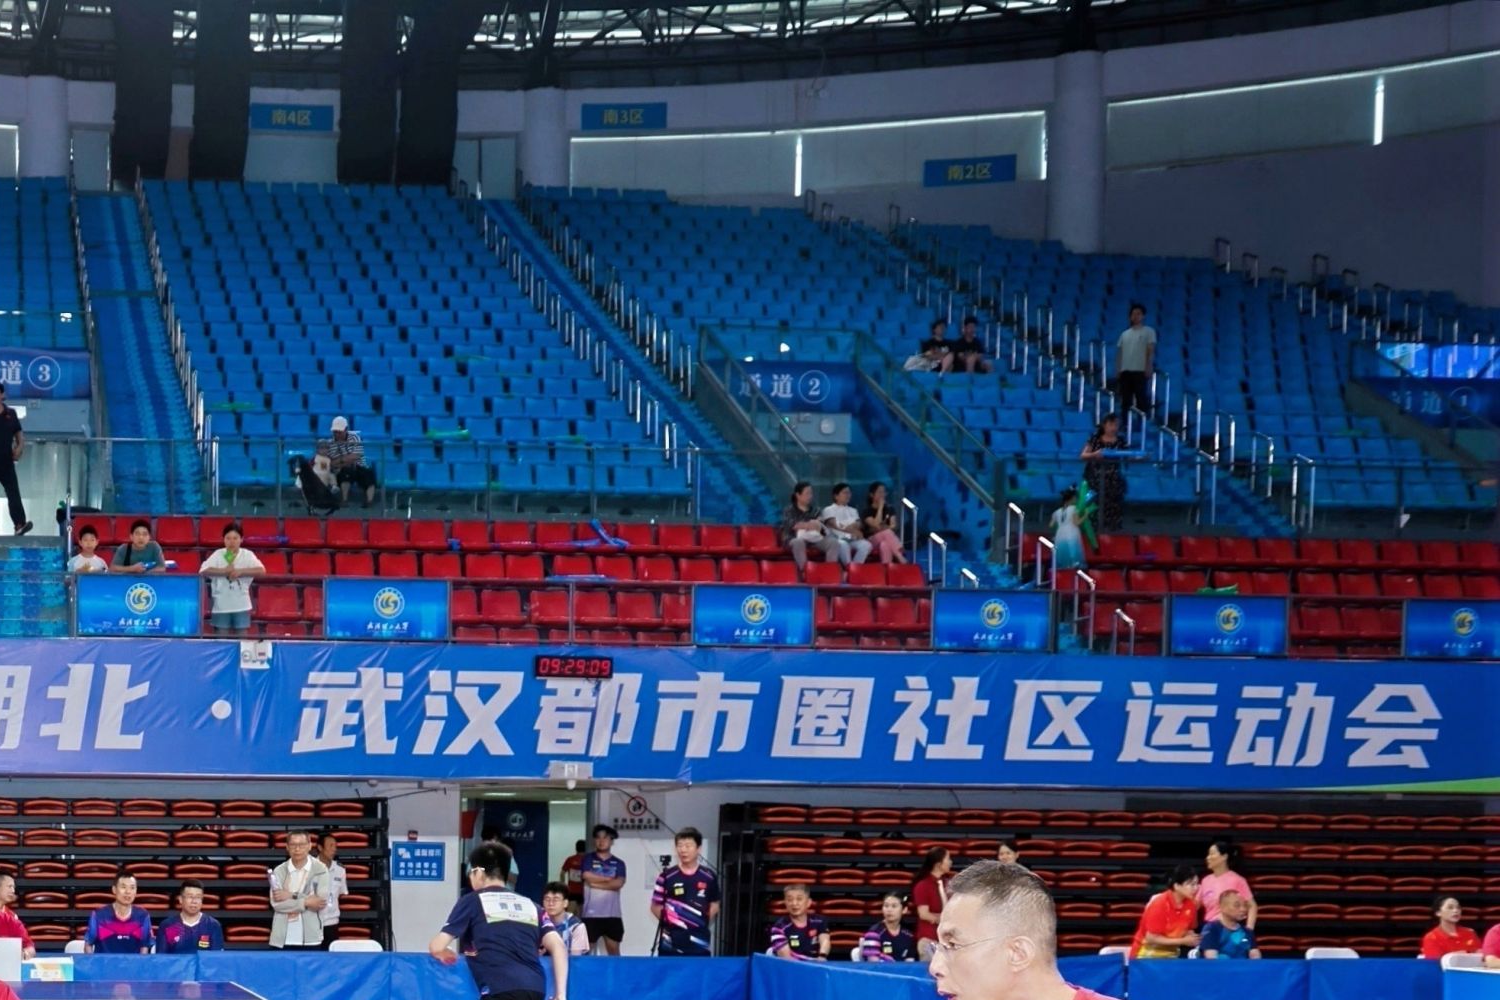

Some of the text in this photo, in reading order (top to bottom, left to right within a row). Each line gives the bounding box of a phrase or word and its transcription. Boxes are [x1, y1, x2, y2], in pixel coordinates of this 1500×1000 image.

[271, 108, 311, 126] 南4区
[603, 108, 644, 126] 南3区
[946, 163, 993, 182] 南2区
[539, 658, 611, 675] 09:29:09
